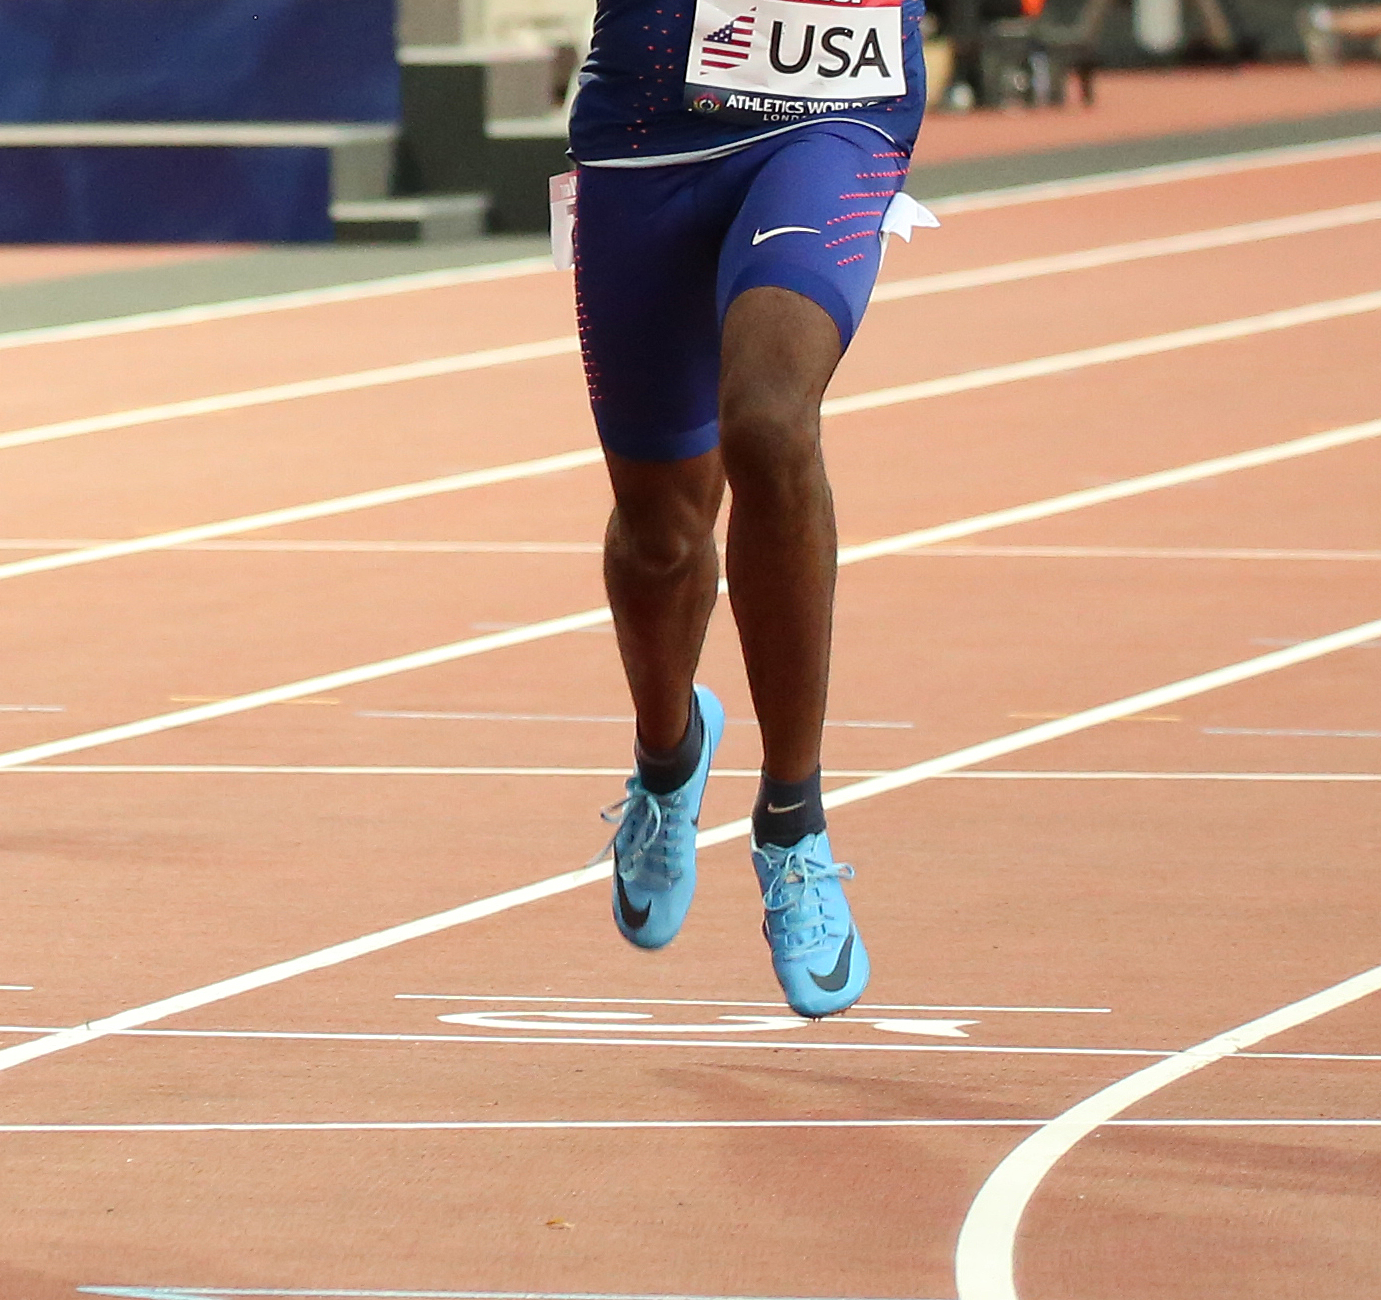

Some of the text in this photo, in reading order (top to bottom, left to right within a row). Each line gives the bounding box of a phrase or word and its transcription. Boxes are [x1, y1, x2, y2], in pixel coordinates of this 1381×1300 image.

[769, 20, 892, 79] USA
[725, 94, 805, 114] ATHLETICS
[762, 113, 808, 121] LOND
